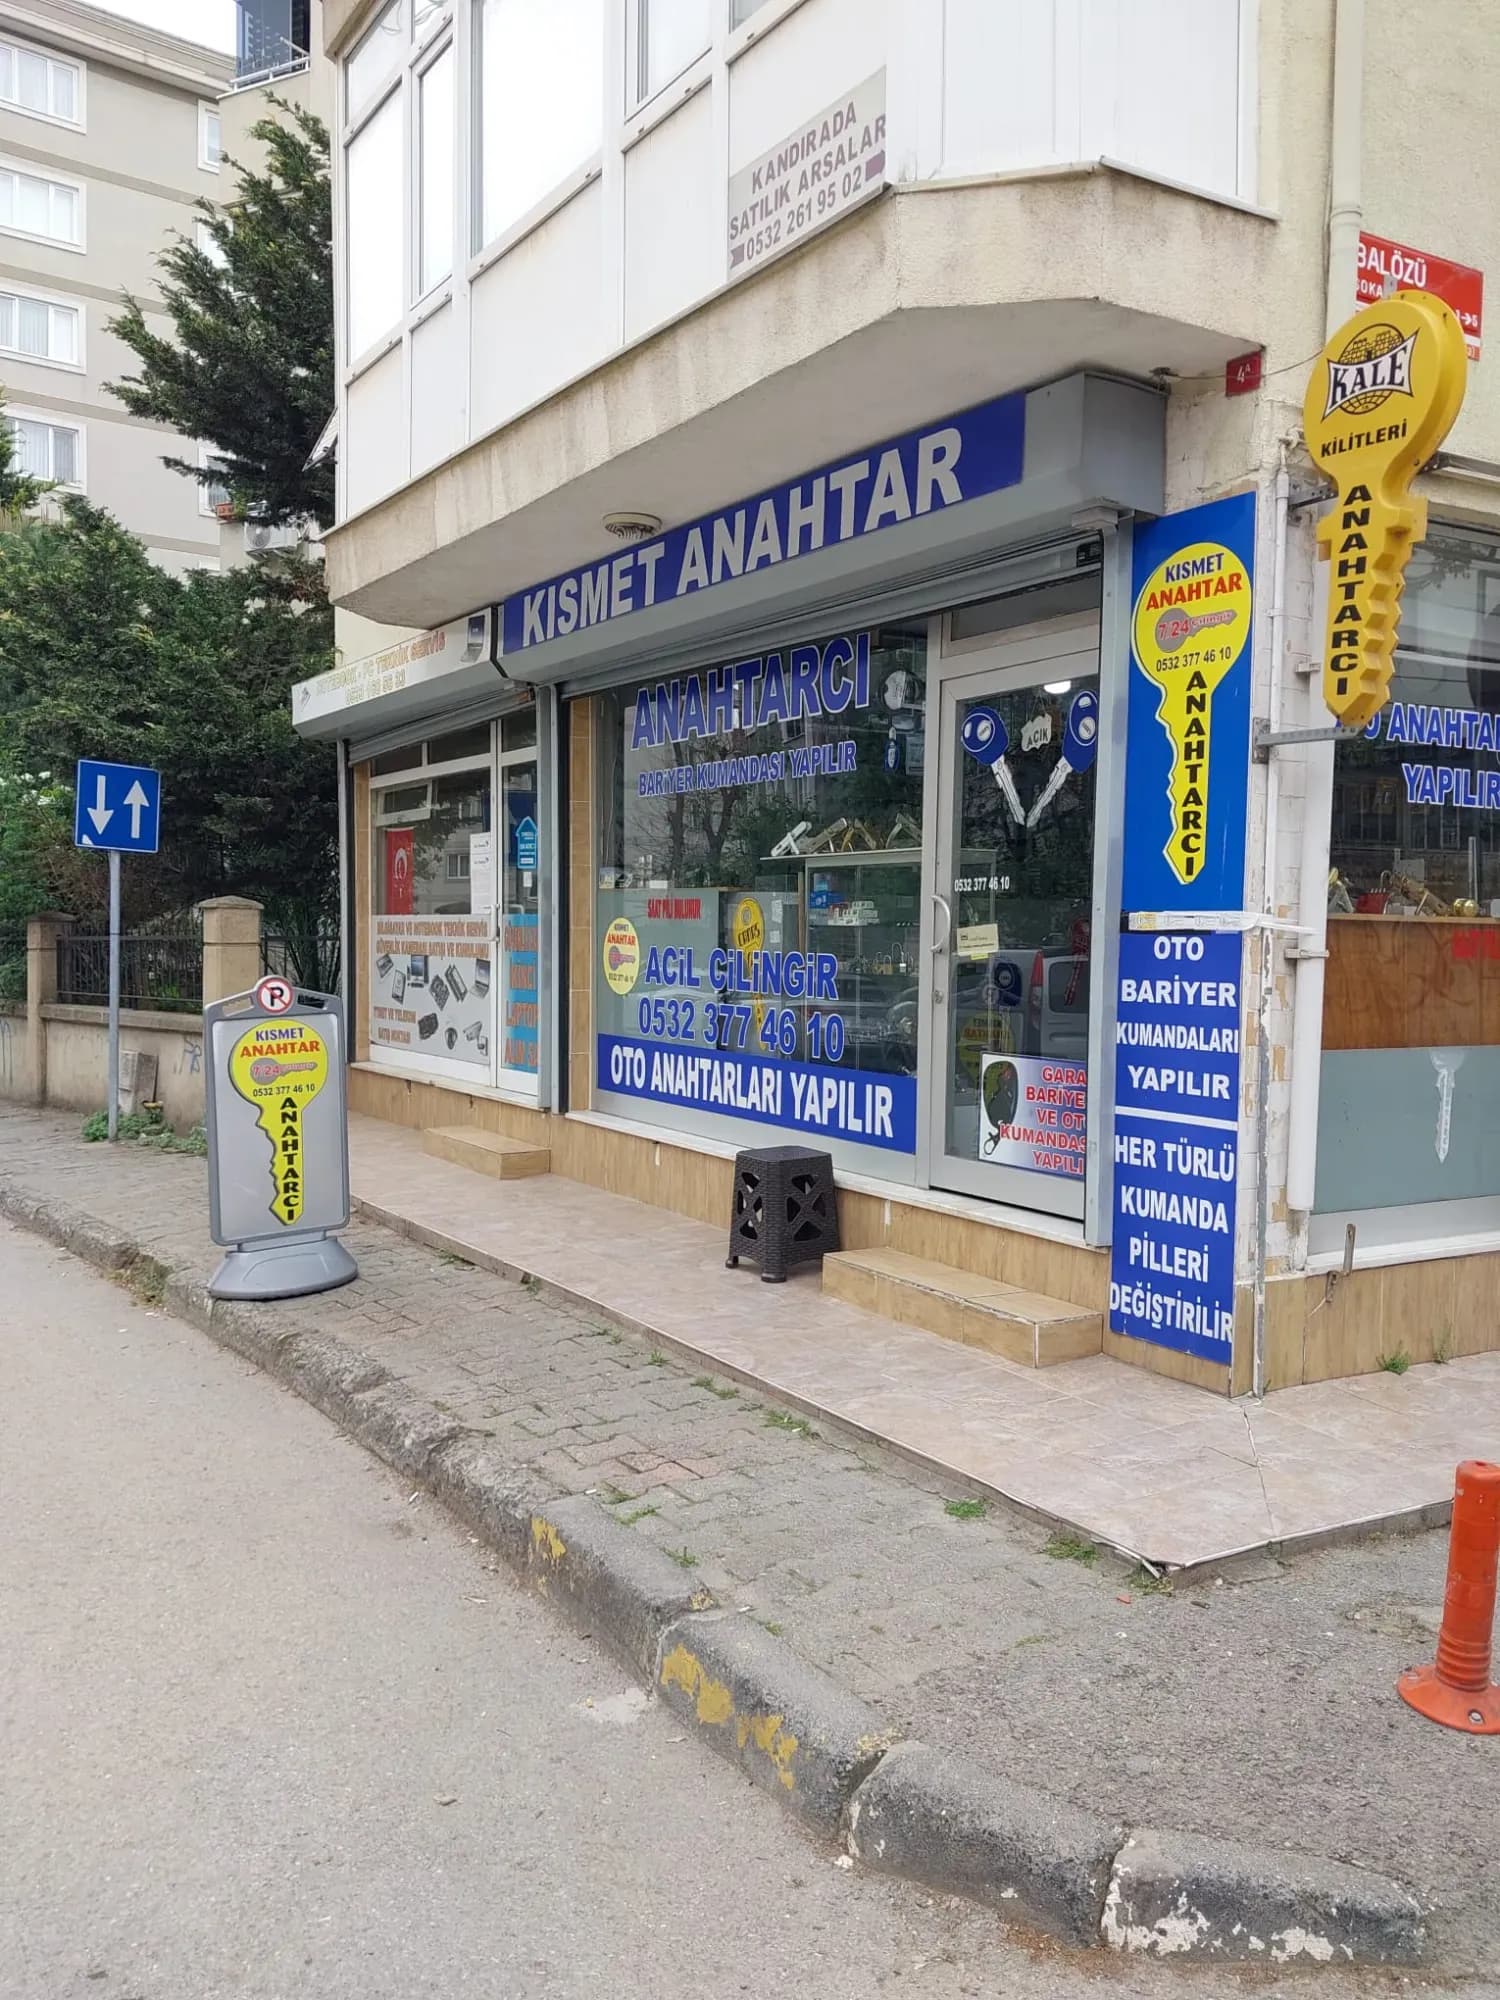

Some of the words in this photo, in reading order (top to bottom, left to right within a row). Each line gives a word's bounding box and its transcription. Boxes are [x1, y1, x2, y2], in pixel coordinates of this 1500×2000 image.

[752, 101, 857, 194] KANDIRADA
[730, 180, 791, 241] SATILIK
[798, 113, 886, 195] ARSALAR
[746, 220, 781, 260] 0532
[787, 201, 812, 235] 261
[818, 183, 836, 214] 95
[842, 164, 862, 198] 02
[1357, 242, 1427, 287] BALÖZÜ
[1331, 346, 1408, 406] KALE
[1320, 418, 1408, 458] KİLİTLERİ
[521, 541, 667, 648] KISMET
[675, 427, 964, 596] ANAHTAR
[1146, 572, 1243, 611] ANAHTAR
[1165, 553, 1225, 583] KISMET
[1330, 484, 1372, 696] ANAHTARCI
[1156, 655, 1180, 672] 0532
[1182, 652, 1200, 668] 377
[1203, 648, 1216, 663] 46
[1219, 646, 1231, 660] 10
[630, 632, 871, 751] ANAHTARCI
[1386, 702, 1500, 752] ANAHTA
[697, 751, 785, 790] KUMANDASI
[790, 740, 857, 779] YAPILIR
[1181, 670, 1208, 876] ANAHTARCI
[1401, 763, 1500, 809] YAPILIR
[954, 878, 972, 892] 0532
[974, 877, 987, 891] 377
[989, 876, 998, 889] 46
[1000, 875, 1010, 889] 10
[1153, 935, 1204, 961] OTO
[1121, 974, 1236, 1007] BARİYER
[240, 1040, 320, 1058] ANAHTAR
[256, 1027, 304, 1041] KISMET
[638, 997, 696, 1041] 0532
[703, 1002, 752, 1048] 377
[760, 1007, 796, 1055] 46
[806, 1011, 845, 1062] 10
[1116, 1021, 1238, 1054] KUMANDALARI
[253, 1087, 273, 1097] 0532
[275, 1086, 290, 1095] 377
[306, 1083, 315, 1092] 10
[610, 1044, 646, 1090] OTO
[651, 1051, 782, 1116] ANAHTARLARI
[790, 1072, 894, 1138] YAPILIR
[1128, 1065, 1230, 1099] YAPILIR
[1036, 1108, 1057, 1126] VE
[1062, 1112, 1087, 1130] OT
[280, 1097, 299, 1221] ANAHTARCI
[1114, 1134, 1157, 1169] HER
[1163, 1136, 1235, 1183] TÜRLÜ
[1121, 1184, 1229, 1234] KUMANDA
[1129, 1231, 1208, 1283] PİLLERİ
[1110, 1280, 1233, 1344] DEĞİŞTİRİLİR
